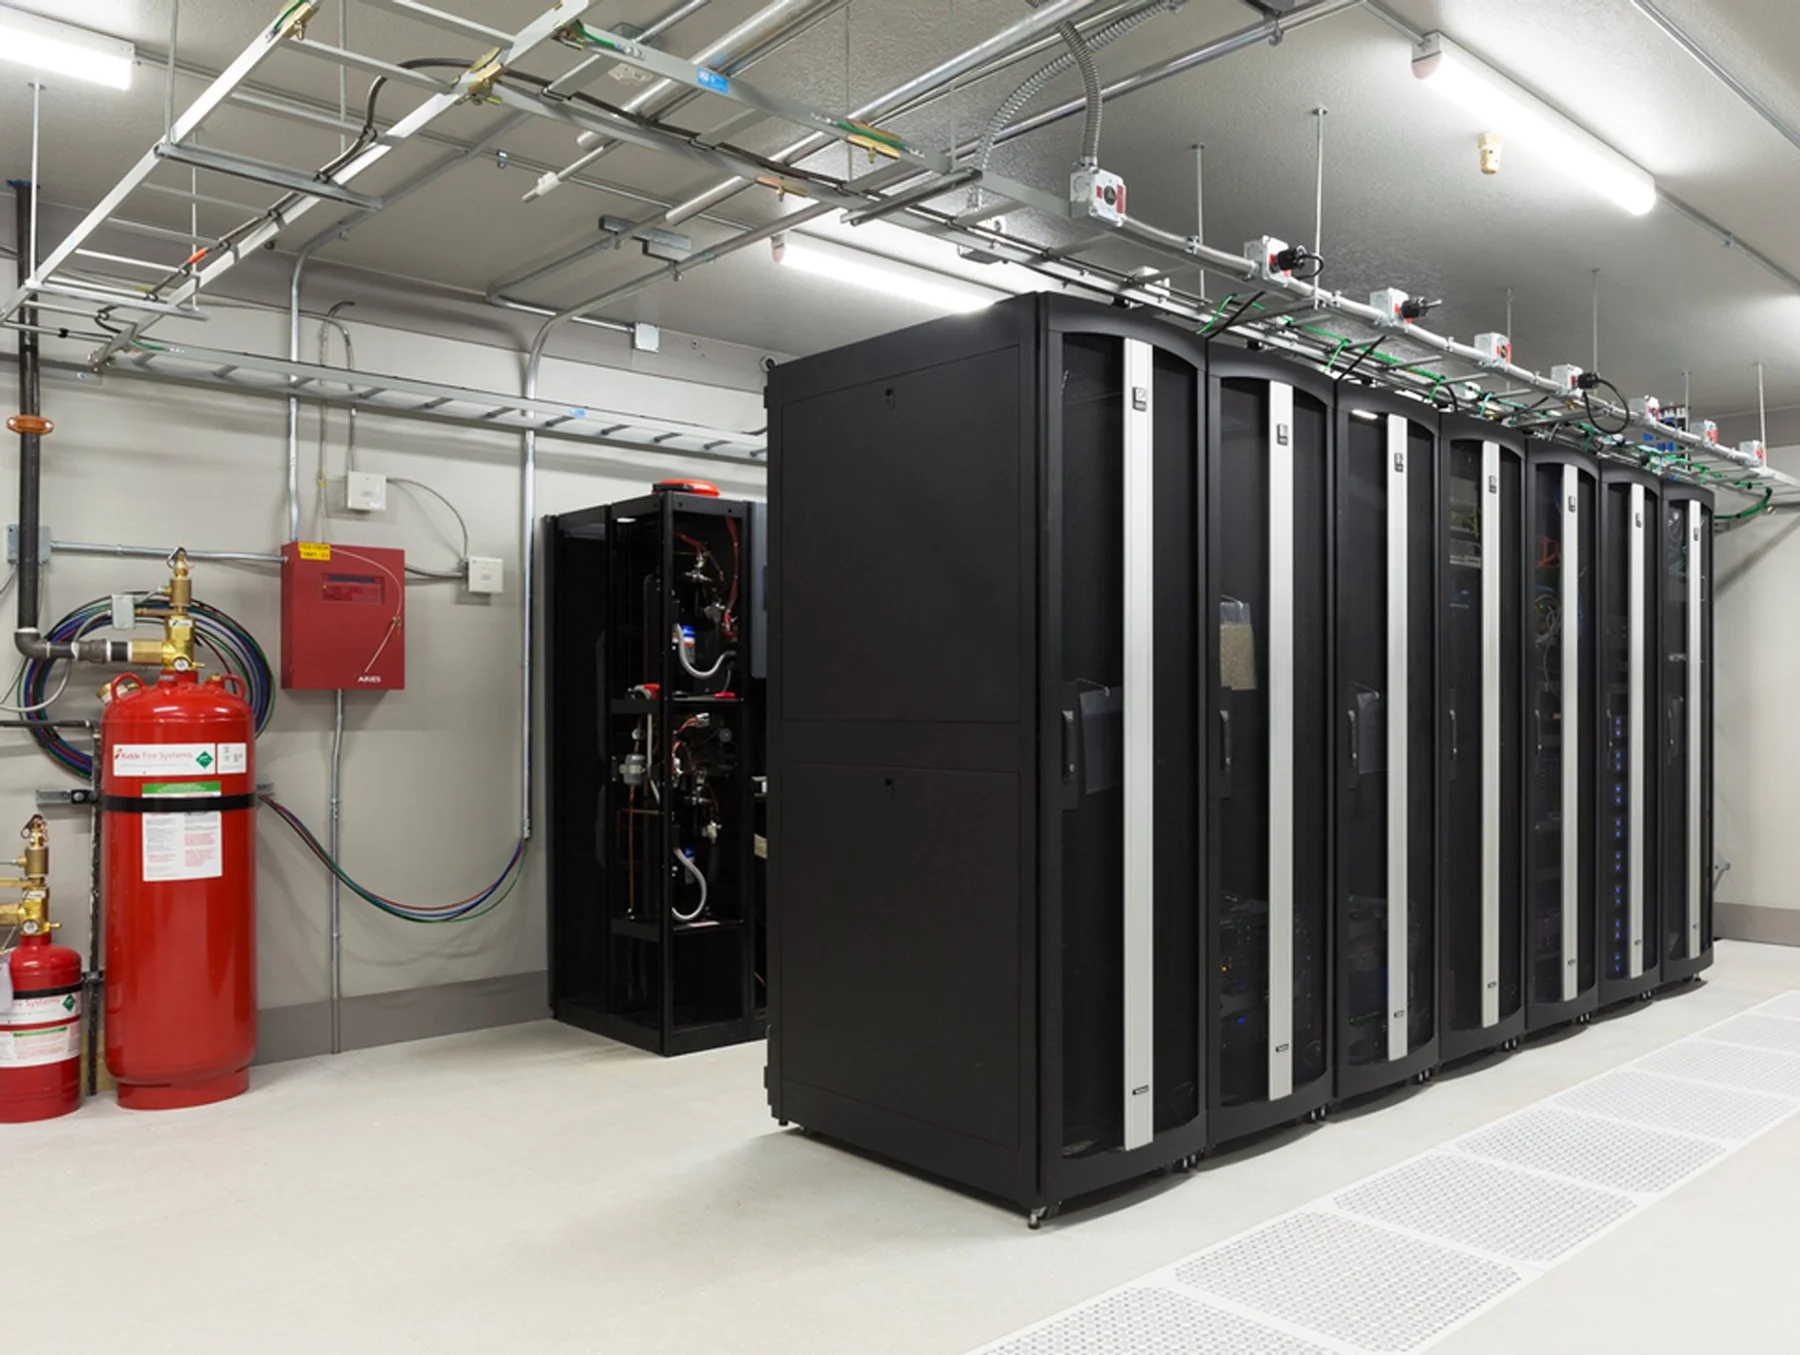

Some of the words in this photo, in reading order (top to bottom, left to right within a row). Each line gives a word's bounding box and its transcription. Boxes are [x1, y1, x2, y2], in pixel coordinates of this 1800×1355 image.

[358, 675, 381, 683] ARIES
[142, 751, 157, 759] Fire
[159, 751, 193, 761] Systems
